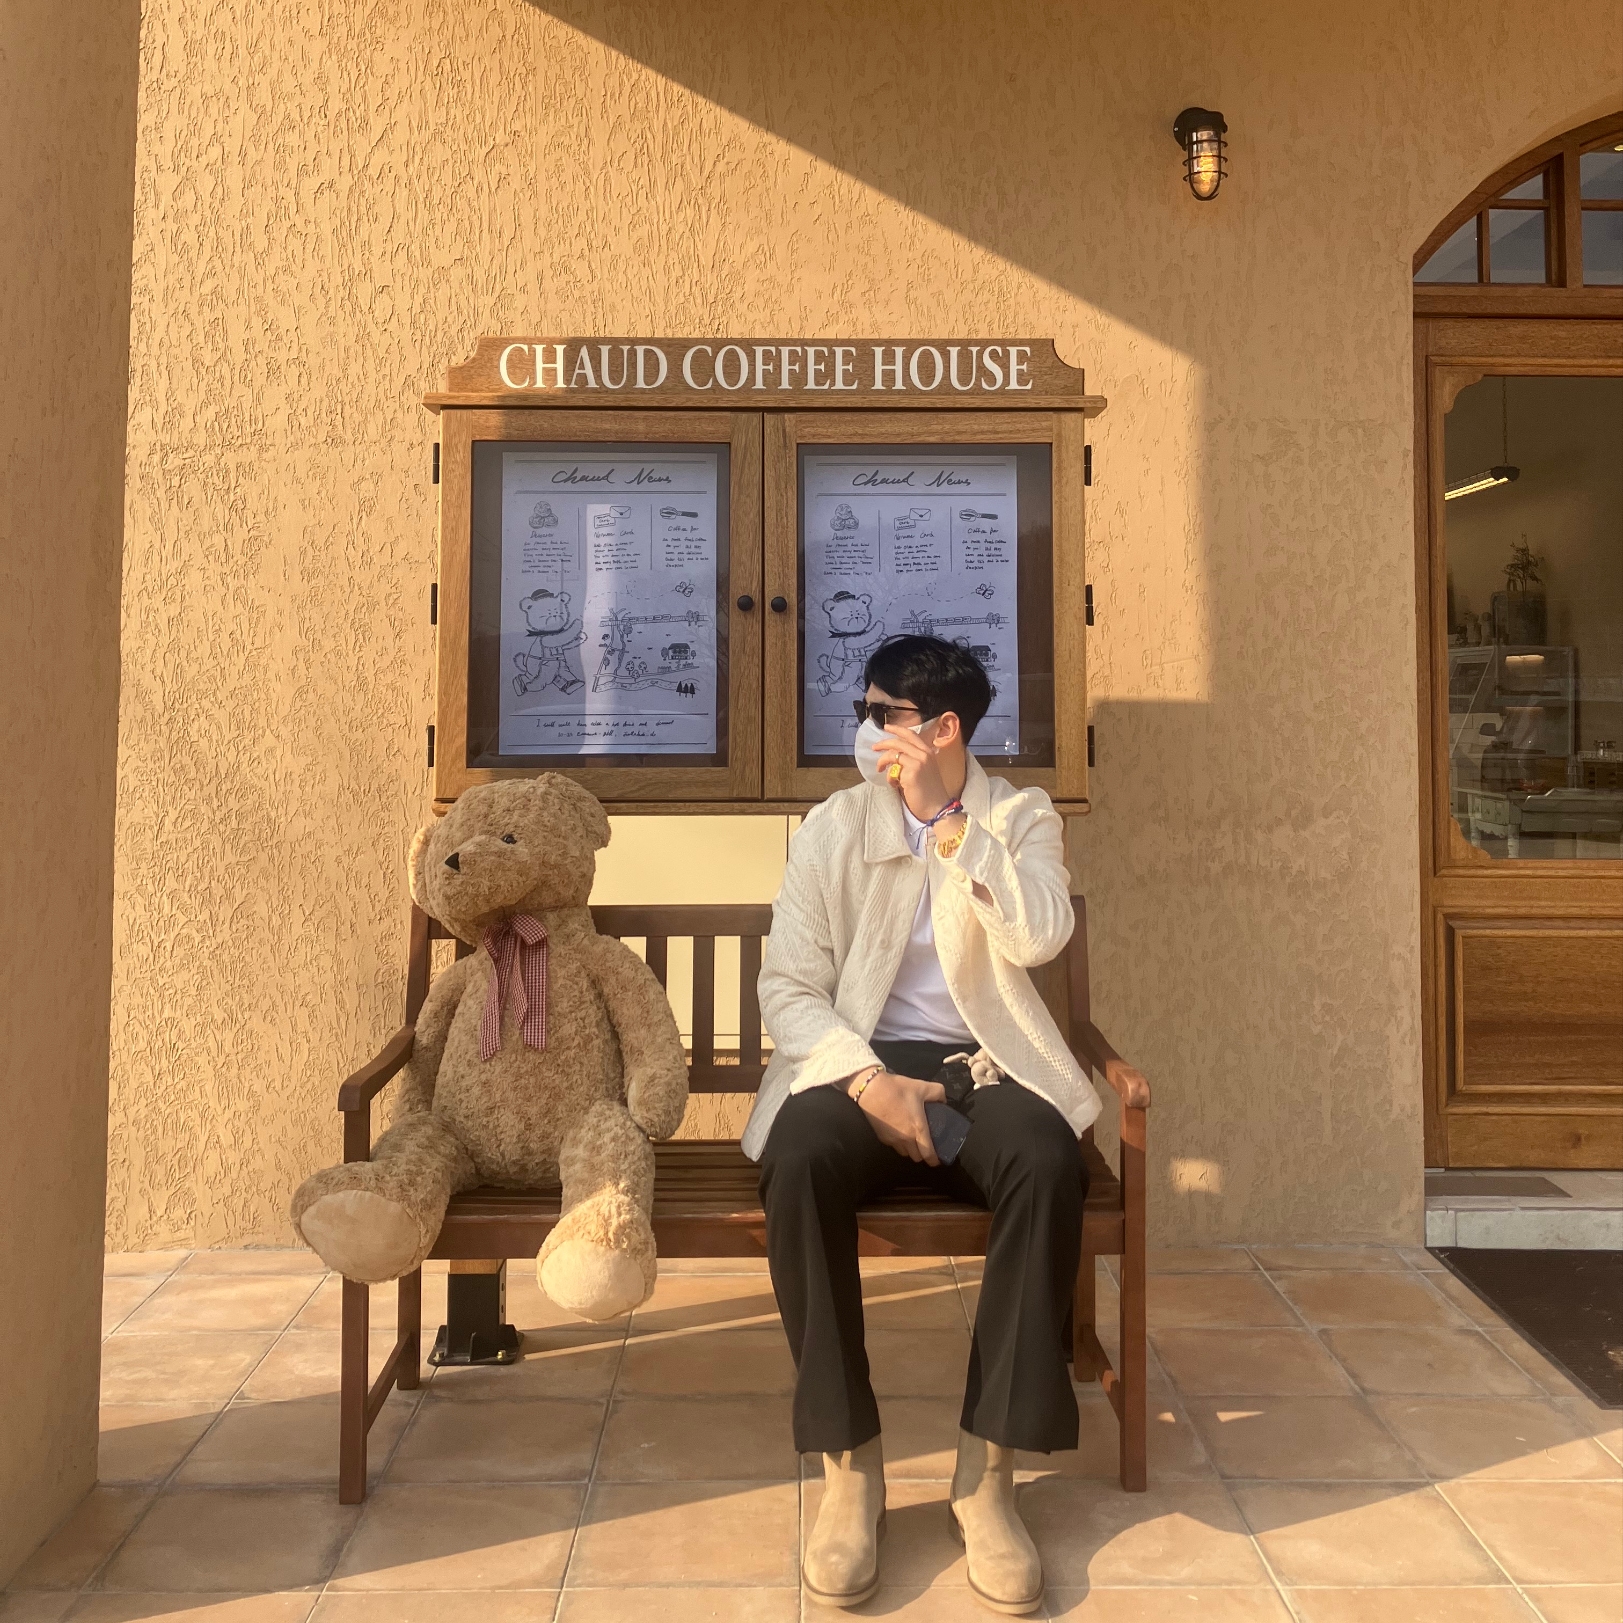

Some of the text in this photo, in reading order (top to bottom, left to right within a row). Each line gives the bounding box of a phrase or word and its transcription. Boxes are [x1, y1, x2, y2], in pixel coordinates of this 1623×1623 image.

[498, 343, 1033, 392] CHAUD COFFEE HOUSE
[551, 466, 672, 485] Chaud News
[852, 470, 972, 487] Chaud News
